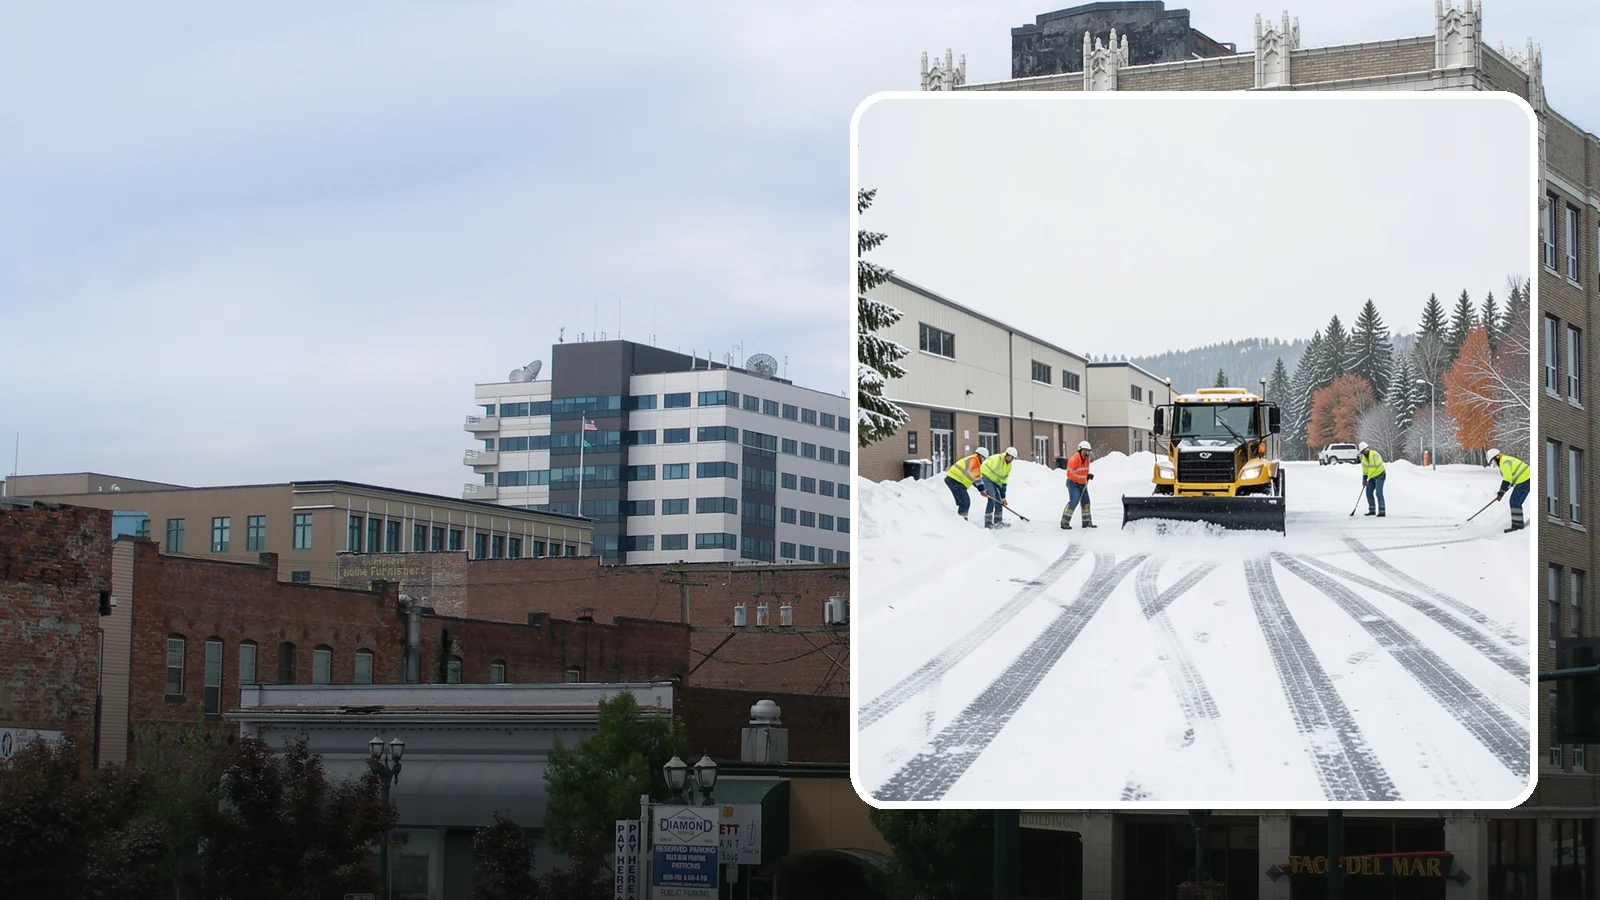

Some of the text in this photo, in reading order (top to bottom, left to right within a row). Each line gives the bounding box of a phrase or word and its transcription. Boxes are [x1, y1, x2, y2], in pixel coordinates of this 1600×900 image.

[660, 818, 713, 833] DIAMOND
[1021, 814, 1070, 828] BUILDING
[719, 823, 740, 836] ETT
[655, 845, 716, 854] RESERVED PARKING
[719, 839, 740, 848] ANT
[616, 825, 625, 894] PAY HERE
[627, 824, 637, 893] PAY HERE
[721, 851, 739, 862] Soup
[671, 862, 701, 870] PATRONS
[1346, 856, 1385, 875] DEL
[1392, 857, 1443, 877] MAR
[660, 888, 710, 898] PUBLIC PARKING
